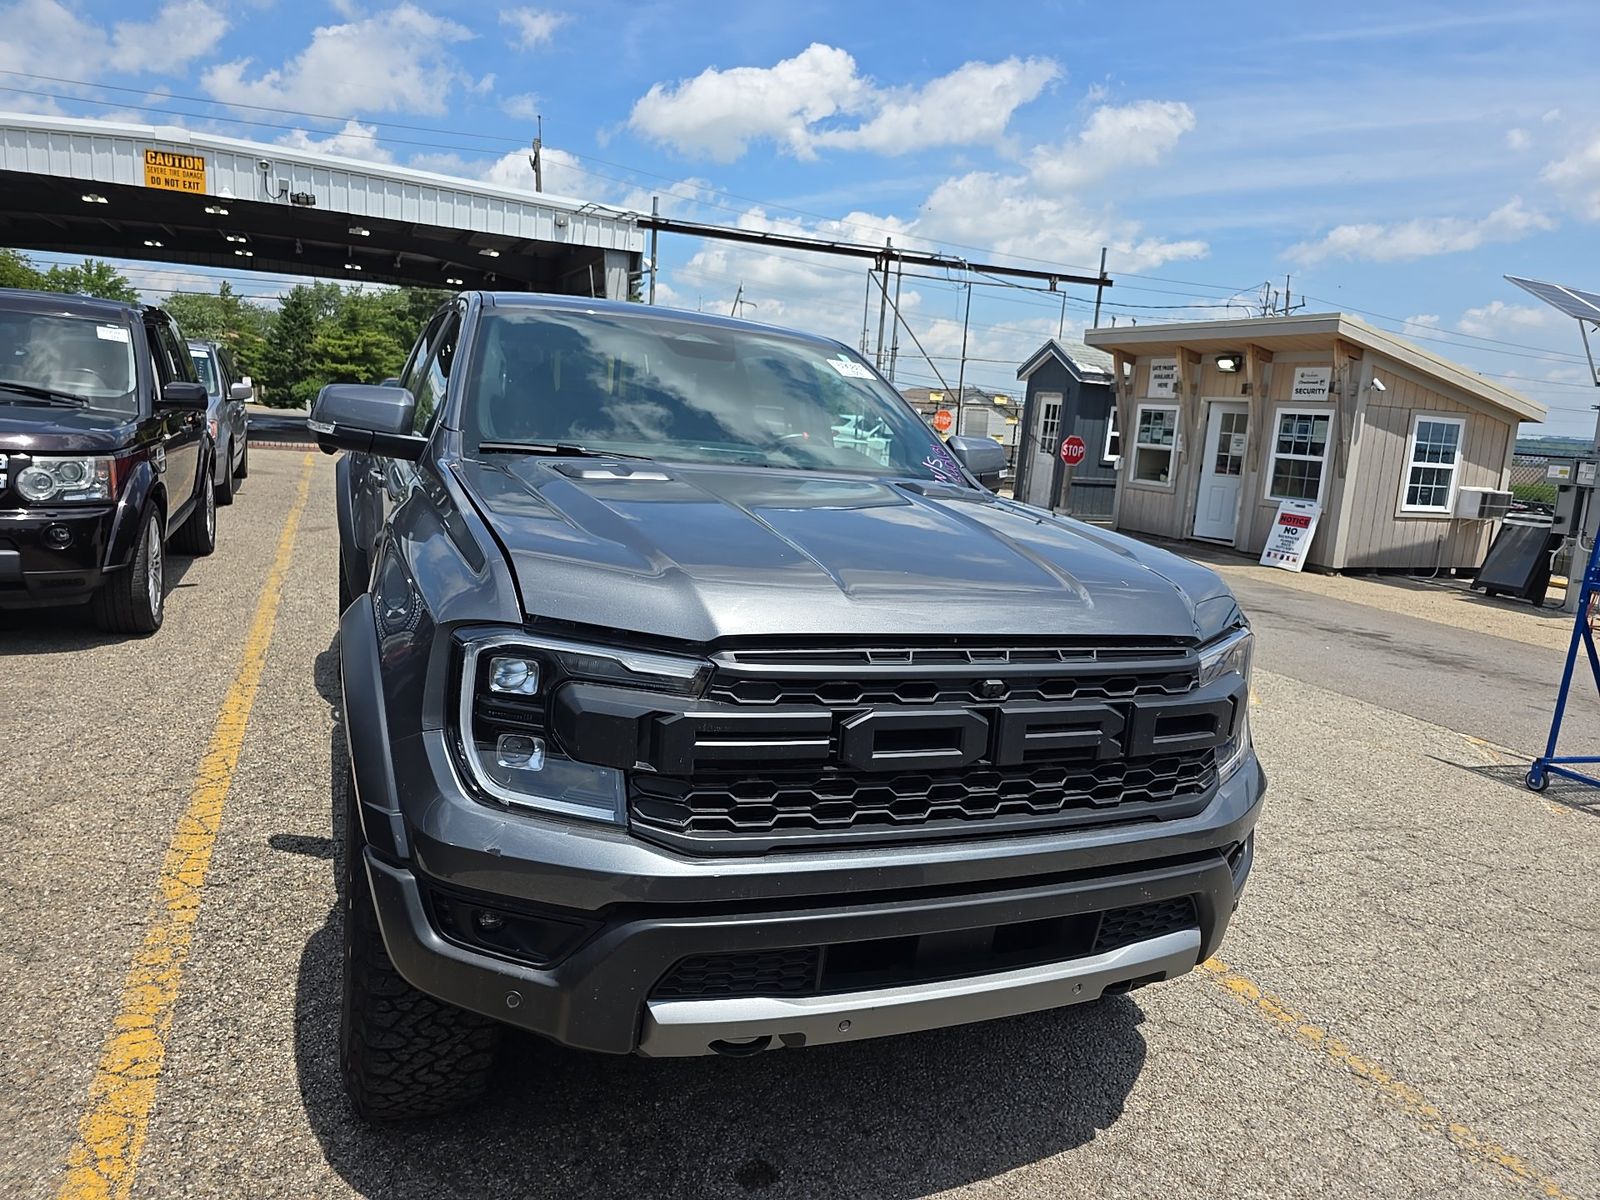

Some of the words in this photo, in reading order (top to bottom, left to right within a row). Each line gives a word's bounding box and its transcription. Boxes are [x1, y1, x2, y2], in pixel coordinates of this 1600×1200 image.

[147, 151, 203, 170] CAUTION
[147, 166, 167, 175] SEVERE
[169, 169, 180, 177] TIRE
[182, 171, 203, 180] DAMAGE
[151, 176, 161, 185] DO
[164, 178, 179, 188] NOT
[183, 180, 200, 190] EXIT
[934, 415, 952, 425] STOP
[1062, 444, 1084, 457] STOP
[1280, 515, 1309, 526] NOTICE
[1283, 526, 1298, 535] NO
[654, 697, 1236, 775] FORD
